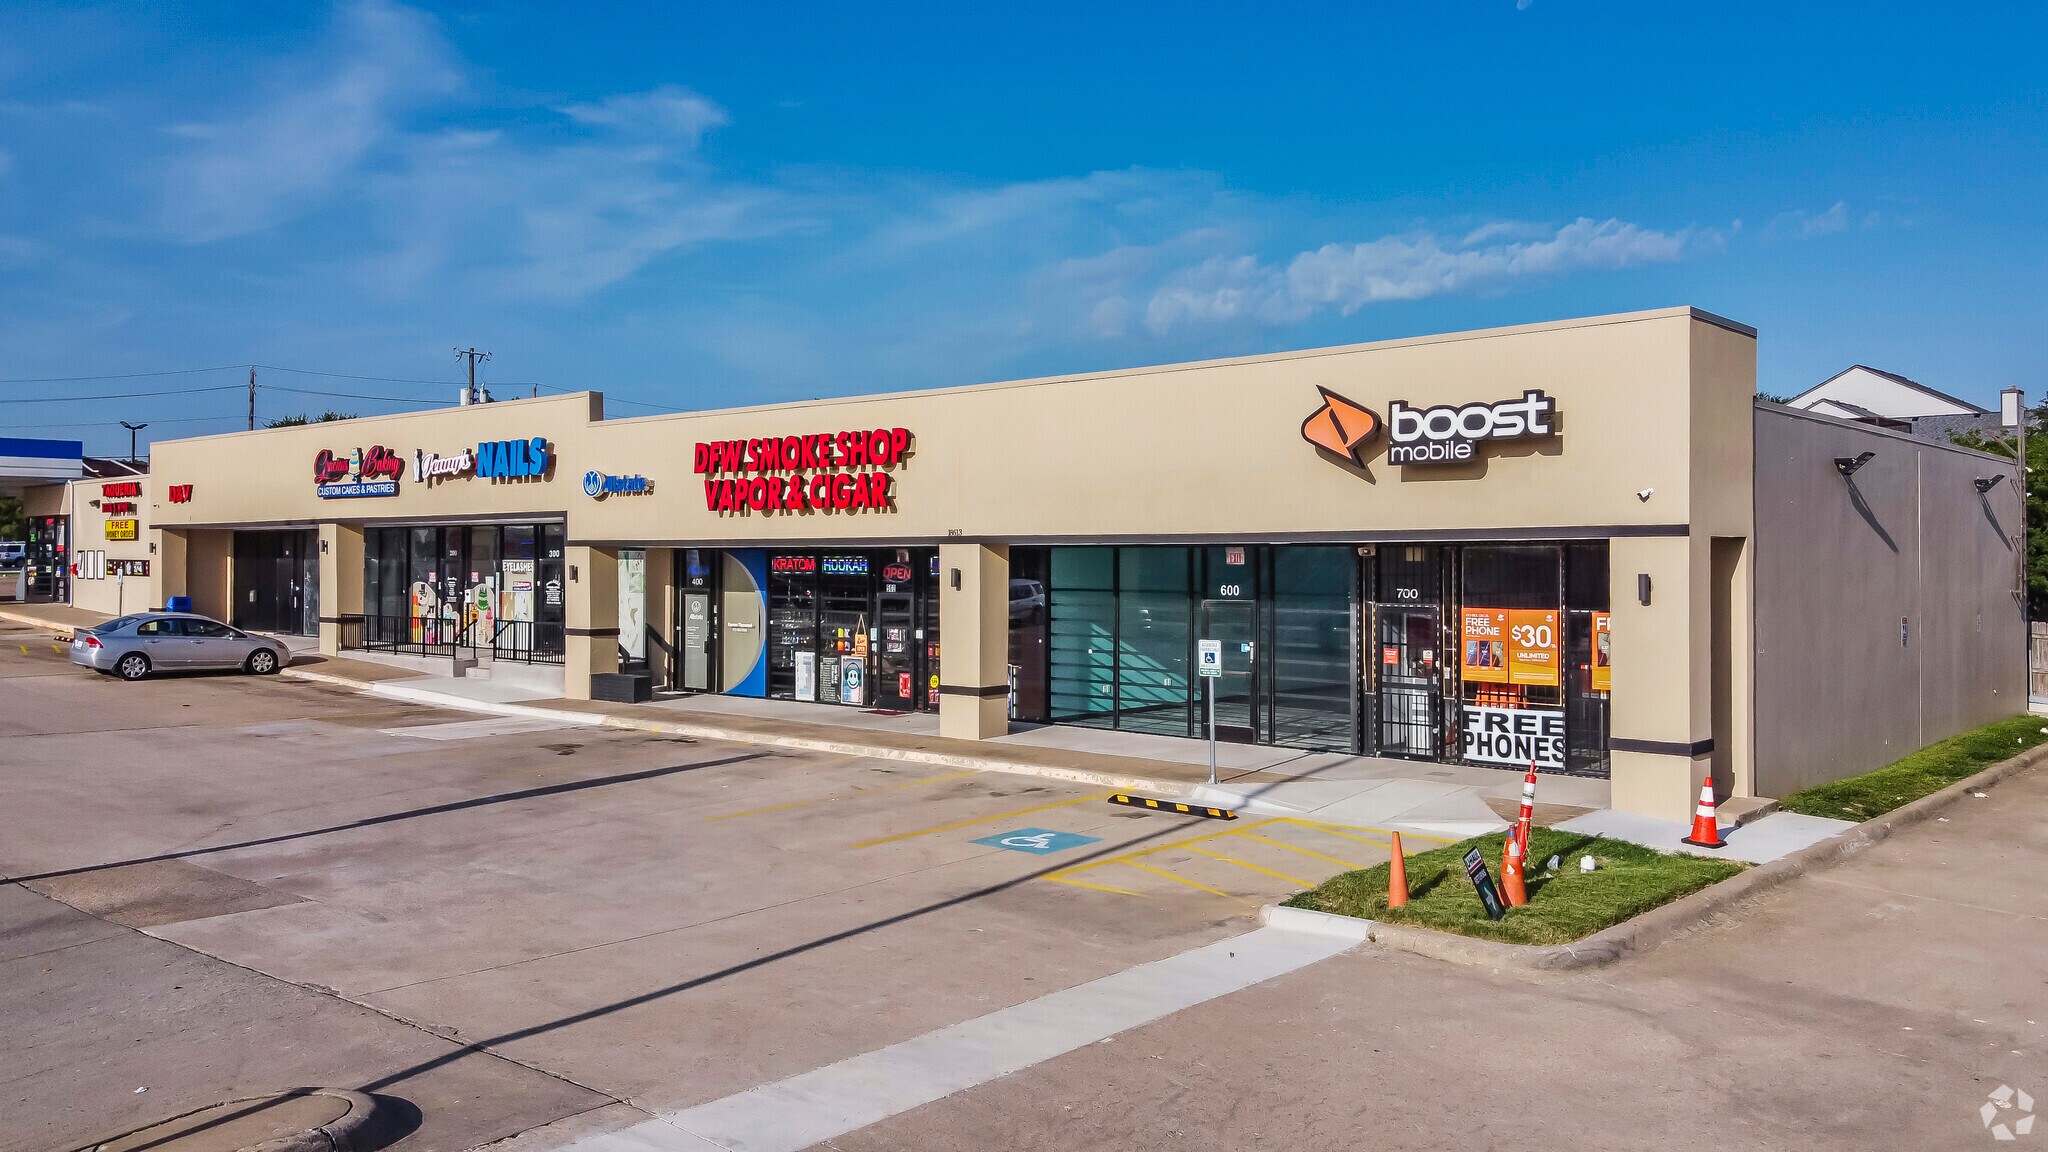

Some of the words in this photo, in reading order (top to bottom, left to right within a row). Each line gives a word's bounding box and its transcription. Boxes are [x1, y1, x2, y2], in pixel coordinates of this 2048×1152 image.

[1391, 393, 1548, 442] boost
[694, 440, 743, 473] DFW
[747, 434, 831, 471] SMOKE
[836, 428, 908, 466] SHOP
[1391, 441, 1471, 461] mobile
[362, 445, 400, 479] Baking
[421, 448, 472, 479] Jenny's
[477, 437, 548, 478] NAILS
[102, 482, 137, 497] TAQUERIA
[169, 484, 190, 502] D&V
[318, 486, 341, 495] CUSTOM
[342, 485, 360, 494] CAKES
[361, 485, 366, 494] &
[366, 483, 395, 494] PASTRIES
[704, 476, 782, 511] VAPOR
[787, 474, 805, 510] &
[810, 472, 888, 509] CIGAR
[111, 521, 129, 530] FREE
[120, 530, 134, 538] ORDER
[502, 562, 534, 572] EYELASHES
[773, 558, 815, 571] KRATOM
[823, 559, 868, 572] HOOKAH
[882, 567, 911, 580] OPEN
[1220, 585, 1240, 596] 600
[1396, 588, 1418, 599] 700
[1465, 617, 1490, 627] FREE
[1465, 626, 1500, 636] PHONE
[1511, 625, 1552, 649] $30
[1516, 652, 1550, 660] UNLIMITED
[1463, 710, 1564, 737] FREE
[1463, 731, 1565, 763] PHONES
